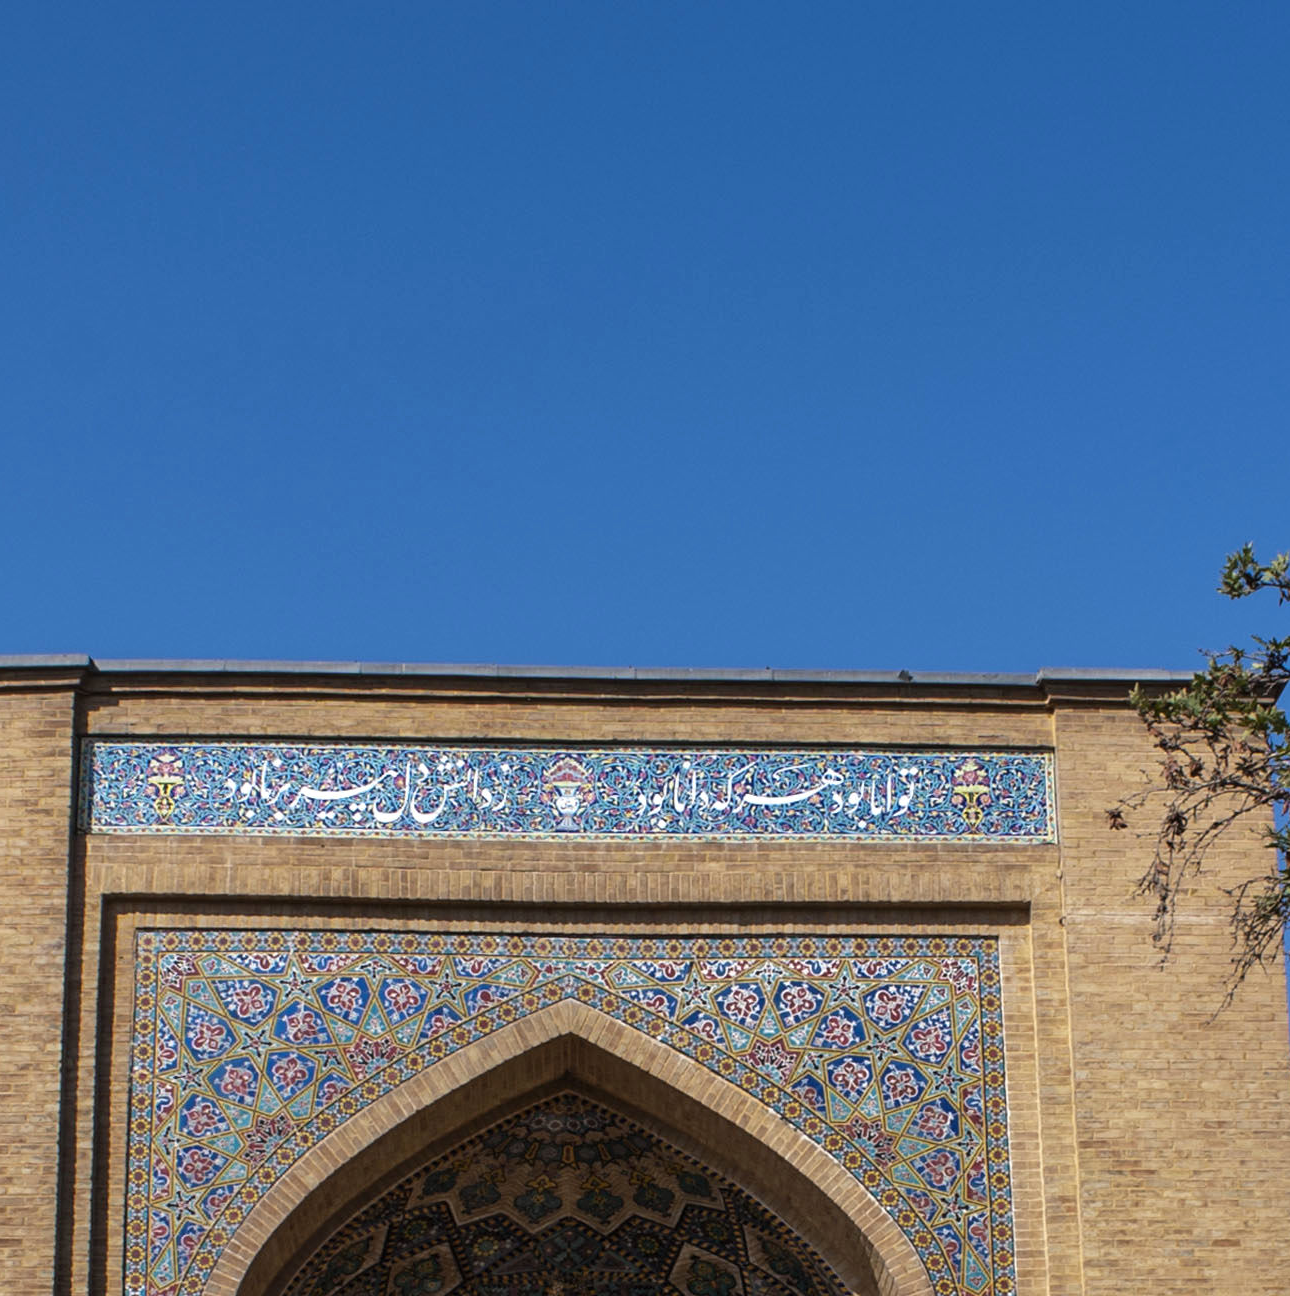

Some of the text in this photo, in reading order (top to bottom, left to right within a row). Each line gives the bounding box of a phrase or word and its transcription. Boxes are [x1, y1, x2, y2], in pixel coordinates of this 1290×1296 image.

[220, 769, 256, 818] بود
[635, 781, 668, 829] بود
[673, 761, 709, 813] دانا
[829, 780, 866, 828] بود
[871, 766, 918, 817] توانا
